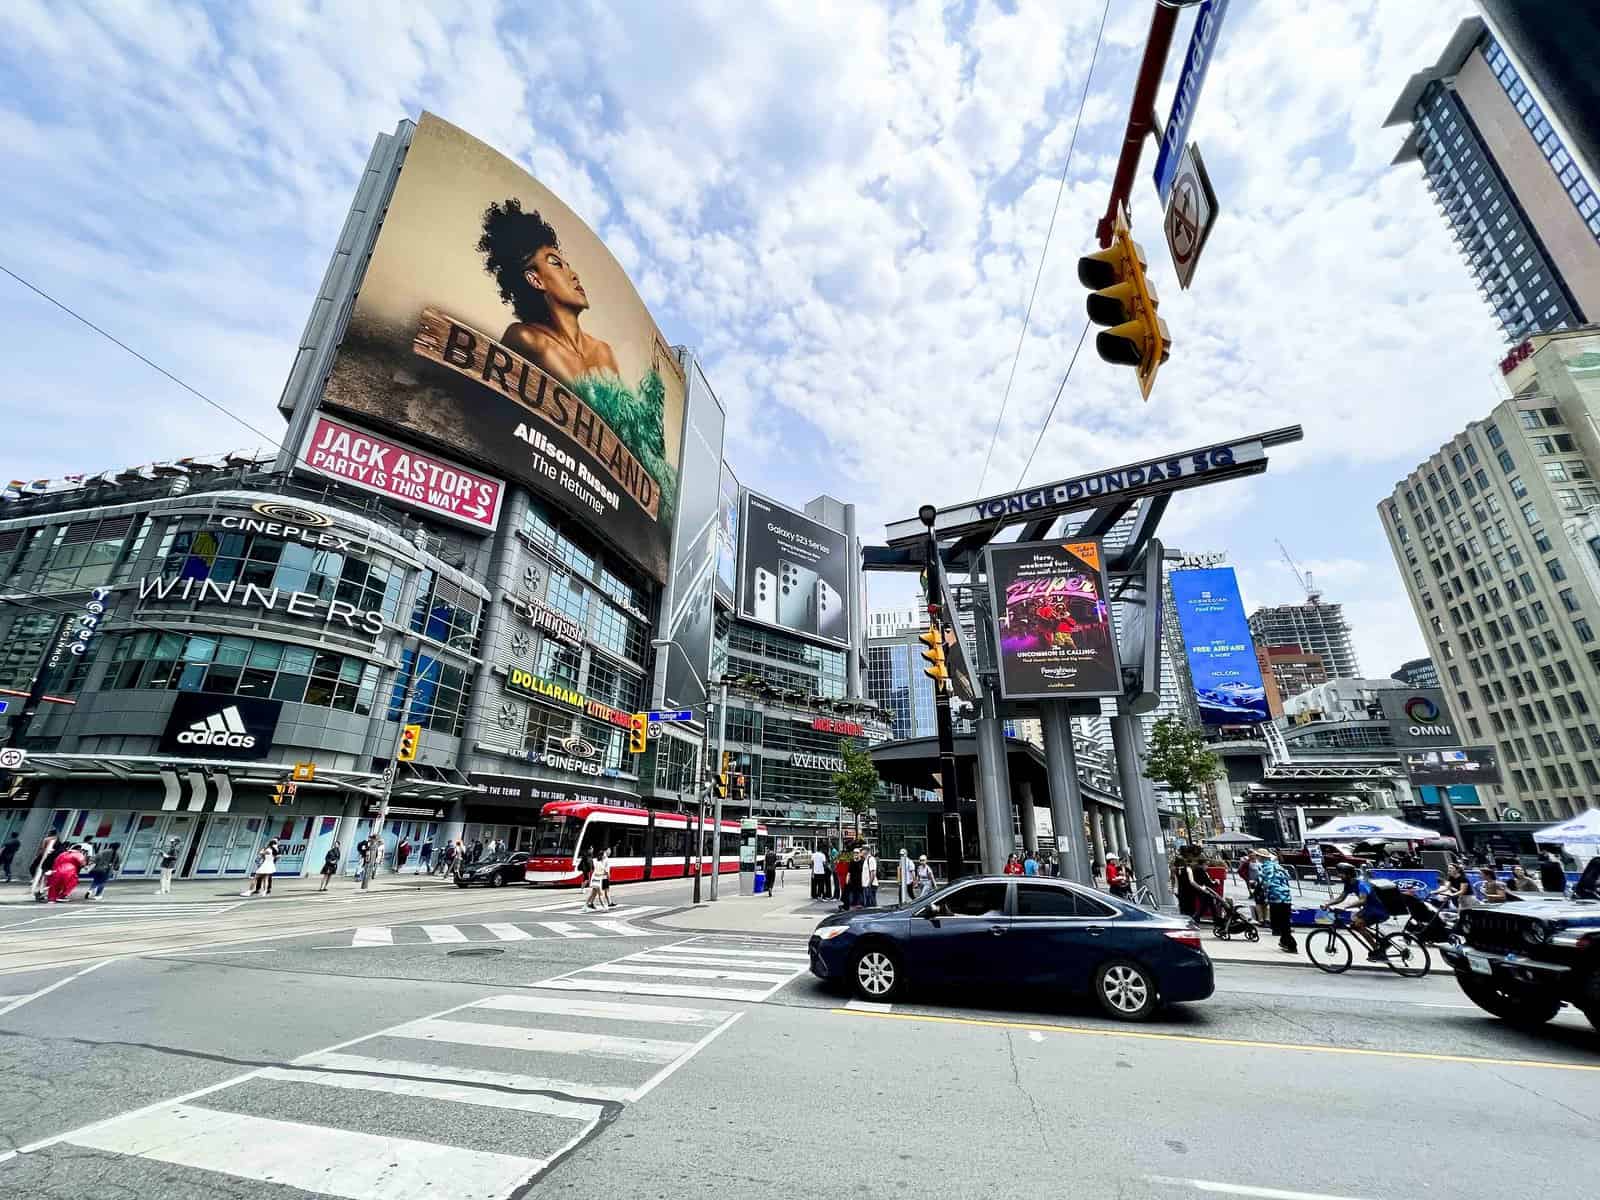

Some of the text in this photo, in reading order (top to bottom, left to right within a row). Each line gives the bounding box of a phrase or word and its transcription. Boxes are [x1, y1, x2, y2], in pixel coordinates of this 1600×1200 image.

[443, 324, 658, 508] BRUSHLAND
[315, 427, 494, 507] JACK ASTOR'S
[513, 423, 620, 511] Allison Russell
[1193, 445, 1236, 471] SQ
[311, 450, 460, 512] PARTY IS THIS WAY
[531, 453, 605, 515] The Returner
[221, 515, 351, 552] CINEPLEX
[767, 522, 795, 542] Galaxy
[139, 576, 385, 635] WINNERS
[48, 617, 75, 668] DOWNTOWN
[511, 669, 584, 708] DOLLARAMA
[587, 701, 611, 720] LITTLE
[176, 729, 256, 749] adidas
[1408, 726, 1452, 737] OMNI
[547, 754, 603, 777] CINEPLEX
